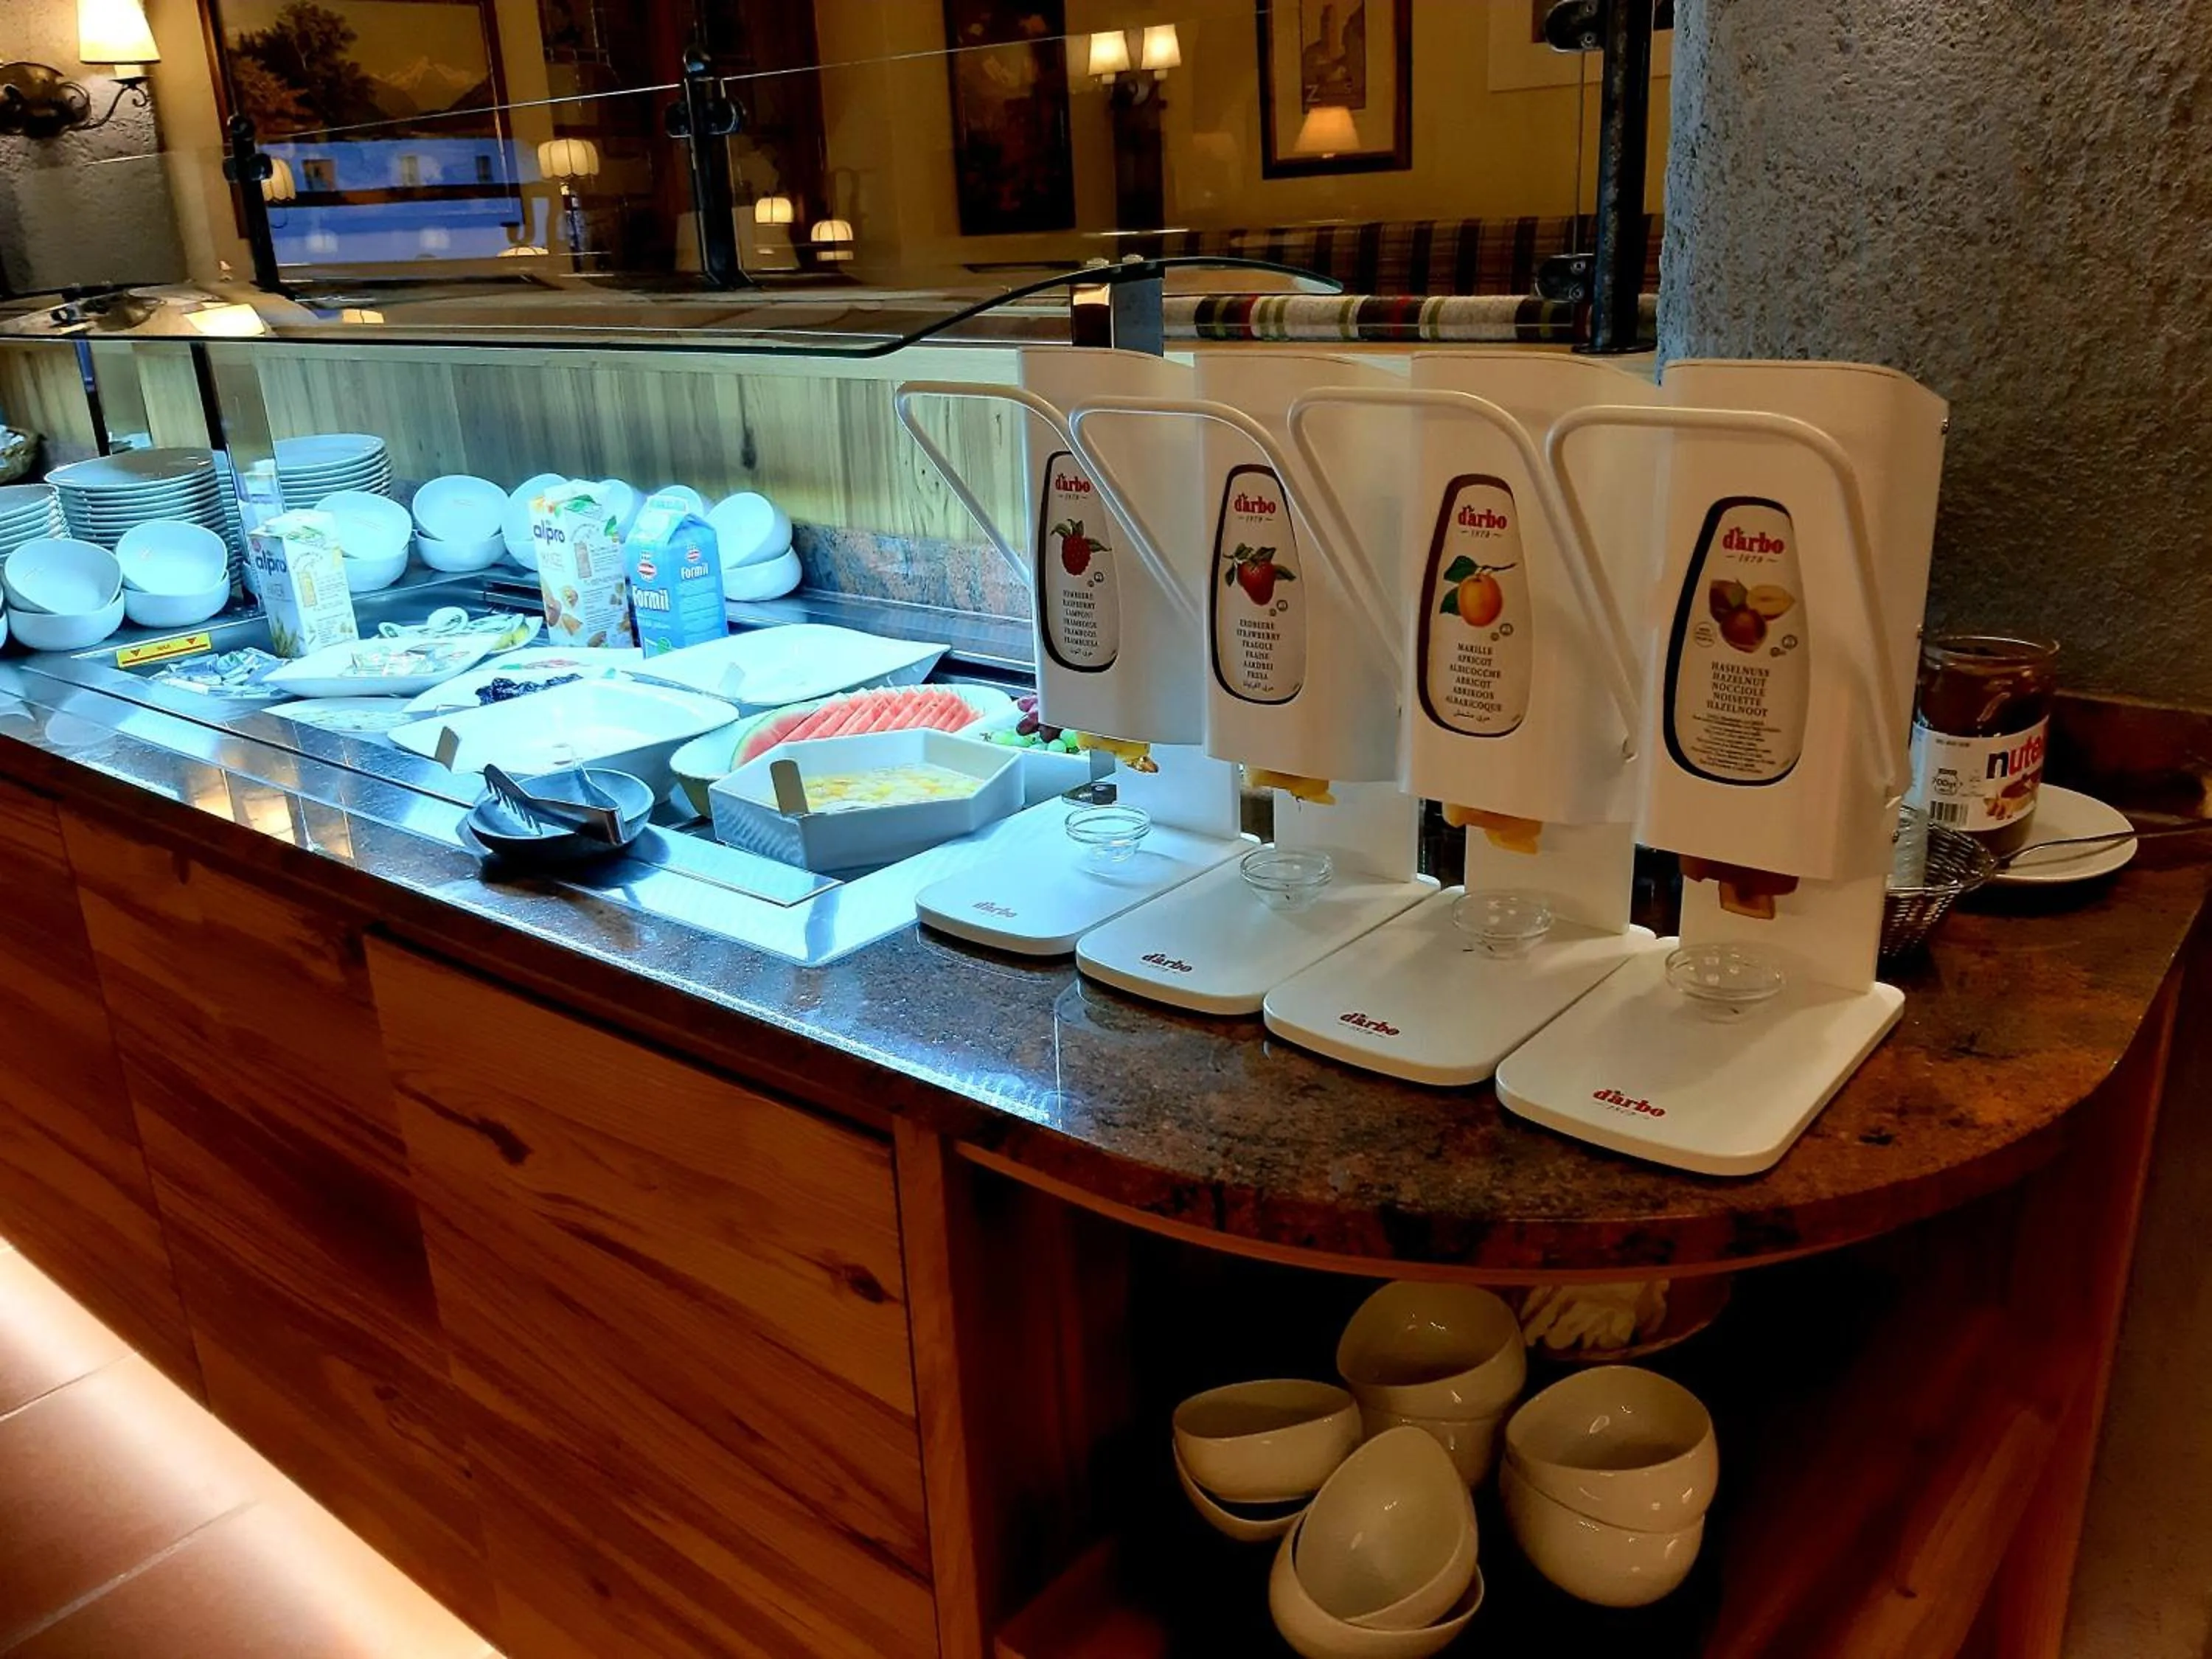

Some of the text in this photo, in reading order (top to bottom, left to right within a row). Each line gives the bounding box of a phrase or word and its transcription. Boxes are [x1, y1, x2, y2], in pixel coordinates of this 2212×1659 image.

[532, 519, 566, 545] alpro
[255, 551, 287, 576] alpro
[1458, 655, 1492, 667] APRICOT
[1711, 661, 1770, 678] HASELNUSS
[1712, 672, 1767, 687] HAZELNUT
[1711, 681, 1767, 697] NOCCIOLE
[1705, 700, 1768, 717] HAZELNOOT
